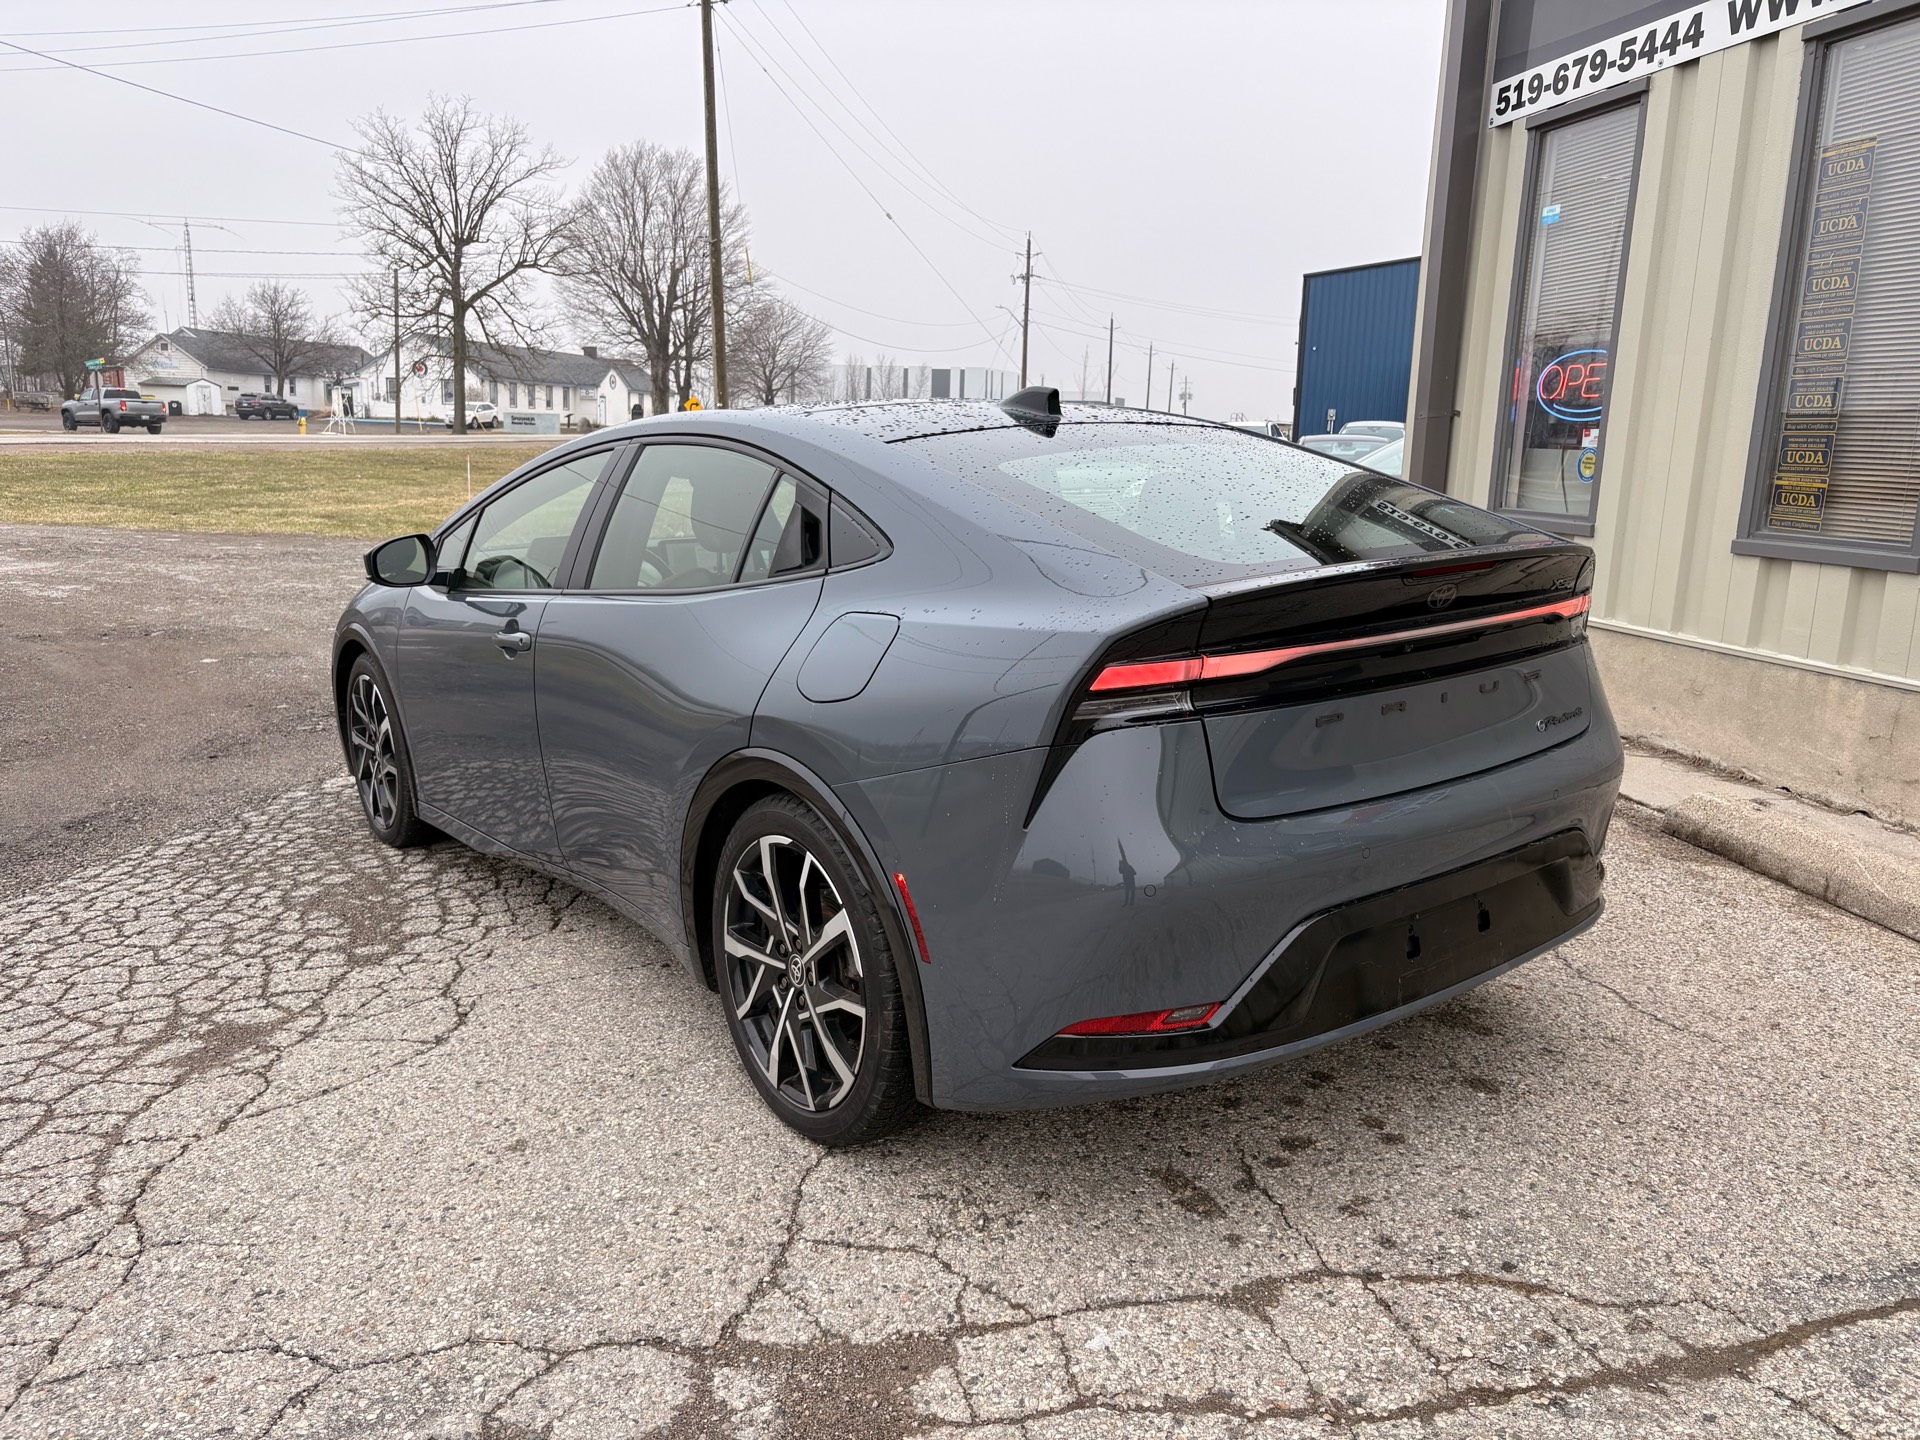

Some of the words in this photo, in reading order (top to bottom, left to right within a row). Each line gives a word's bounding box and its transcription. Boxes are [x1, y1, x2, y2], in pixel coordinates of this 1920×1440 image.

[1495, 12, 1704, 116] 519-679-5444
[1728, 0, 1833, 35] WW
[1828, 157, 1865, 176] UCDA
[1820, 217, 1858, 233] UCDA
[1812, 275, 1850, 291] UCDA
[1804, 336, 1841, 351] UCDA
[1795, 394, 1832, 408] UCDA
[1786, 451, 1824, 464] UCDA
[1781, 492, 1816, 507] UCDA
[1791, 521, 1816, 530] Confidence
[1315, 669, 1542, 728] PRIUS
